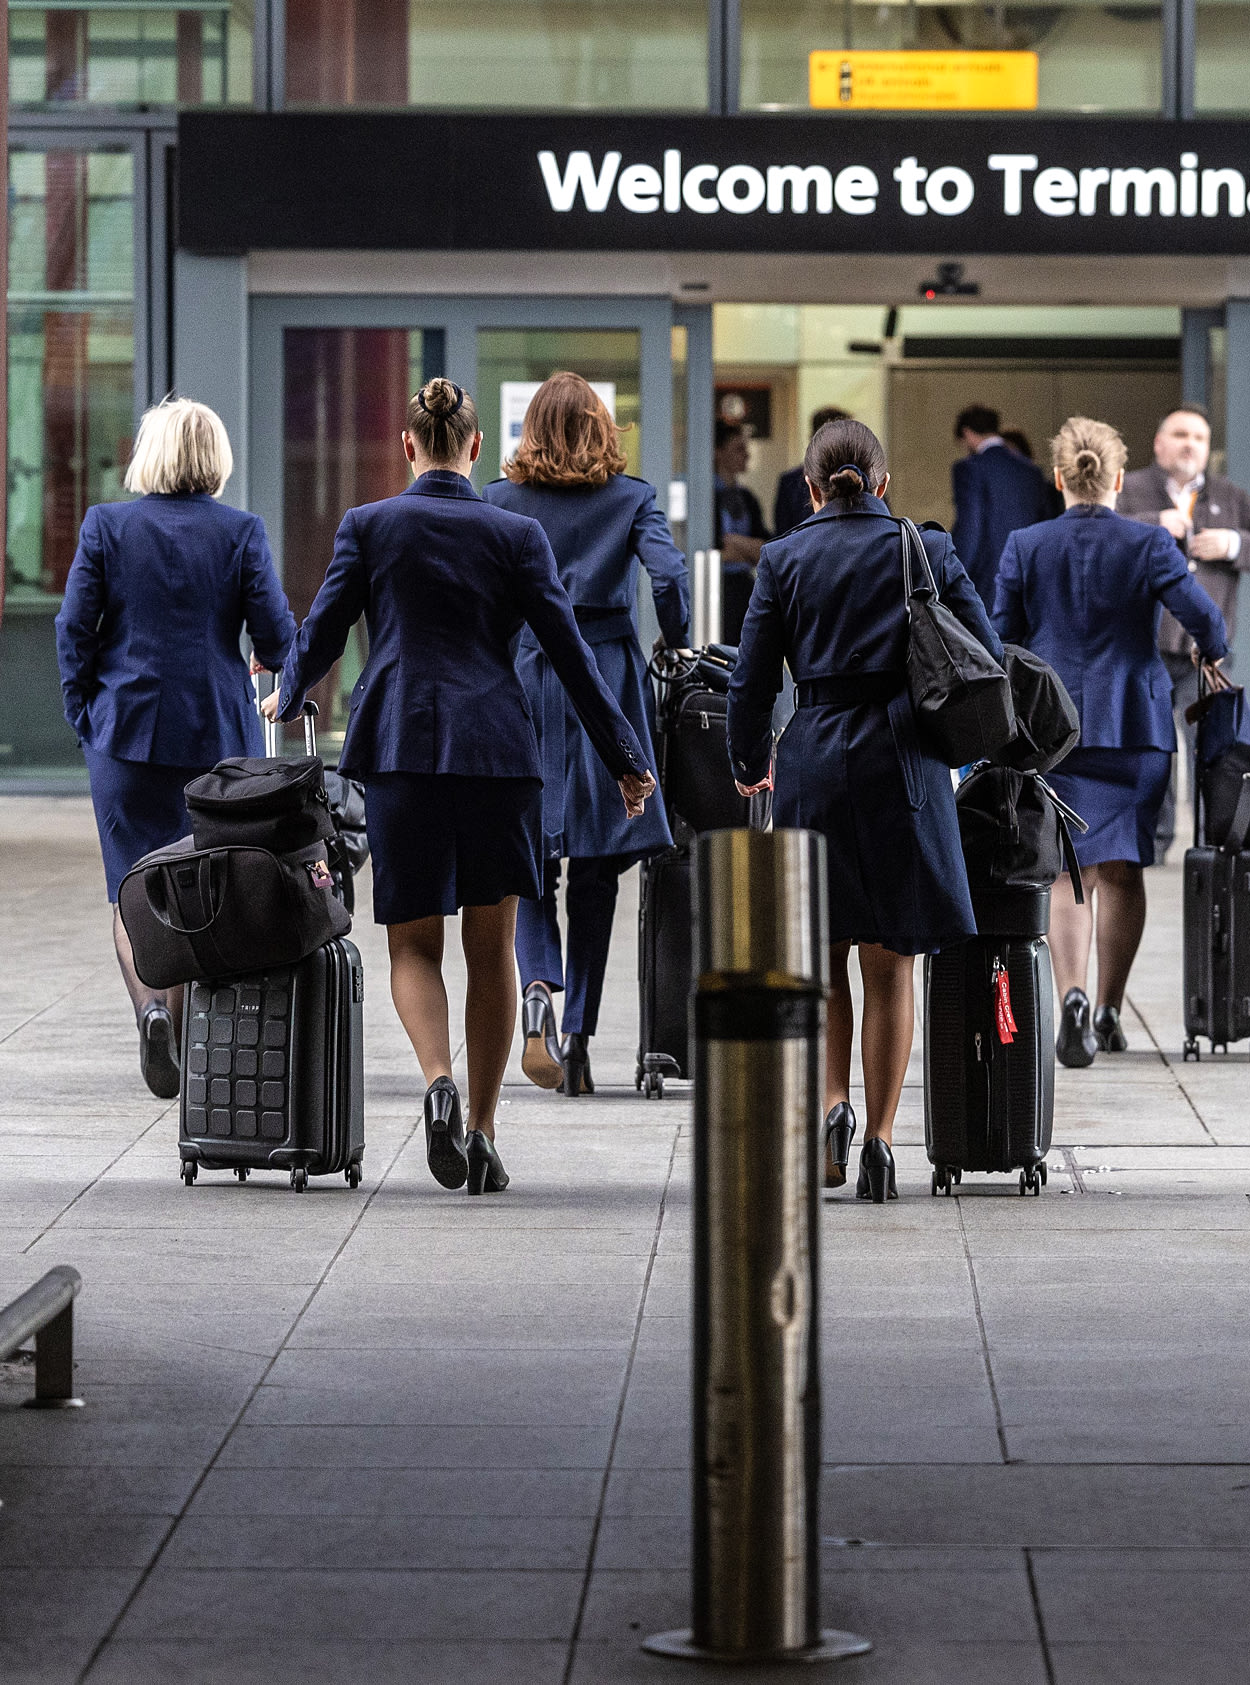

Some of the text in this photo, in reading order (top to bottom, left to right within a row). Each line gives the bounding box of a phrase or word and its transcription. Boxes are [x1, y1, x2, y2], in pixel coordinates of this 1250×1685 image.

[537, 149, 879, 215] Welcome
[892, 156, 975, 216] to
[1001, 982, 1009, 1004] Cabin
[1004, 1005, 1013, 1024] Crew
